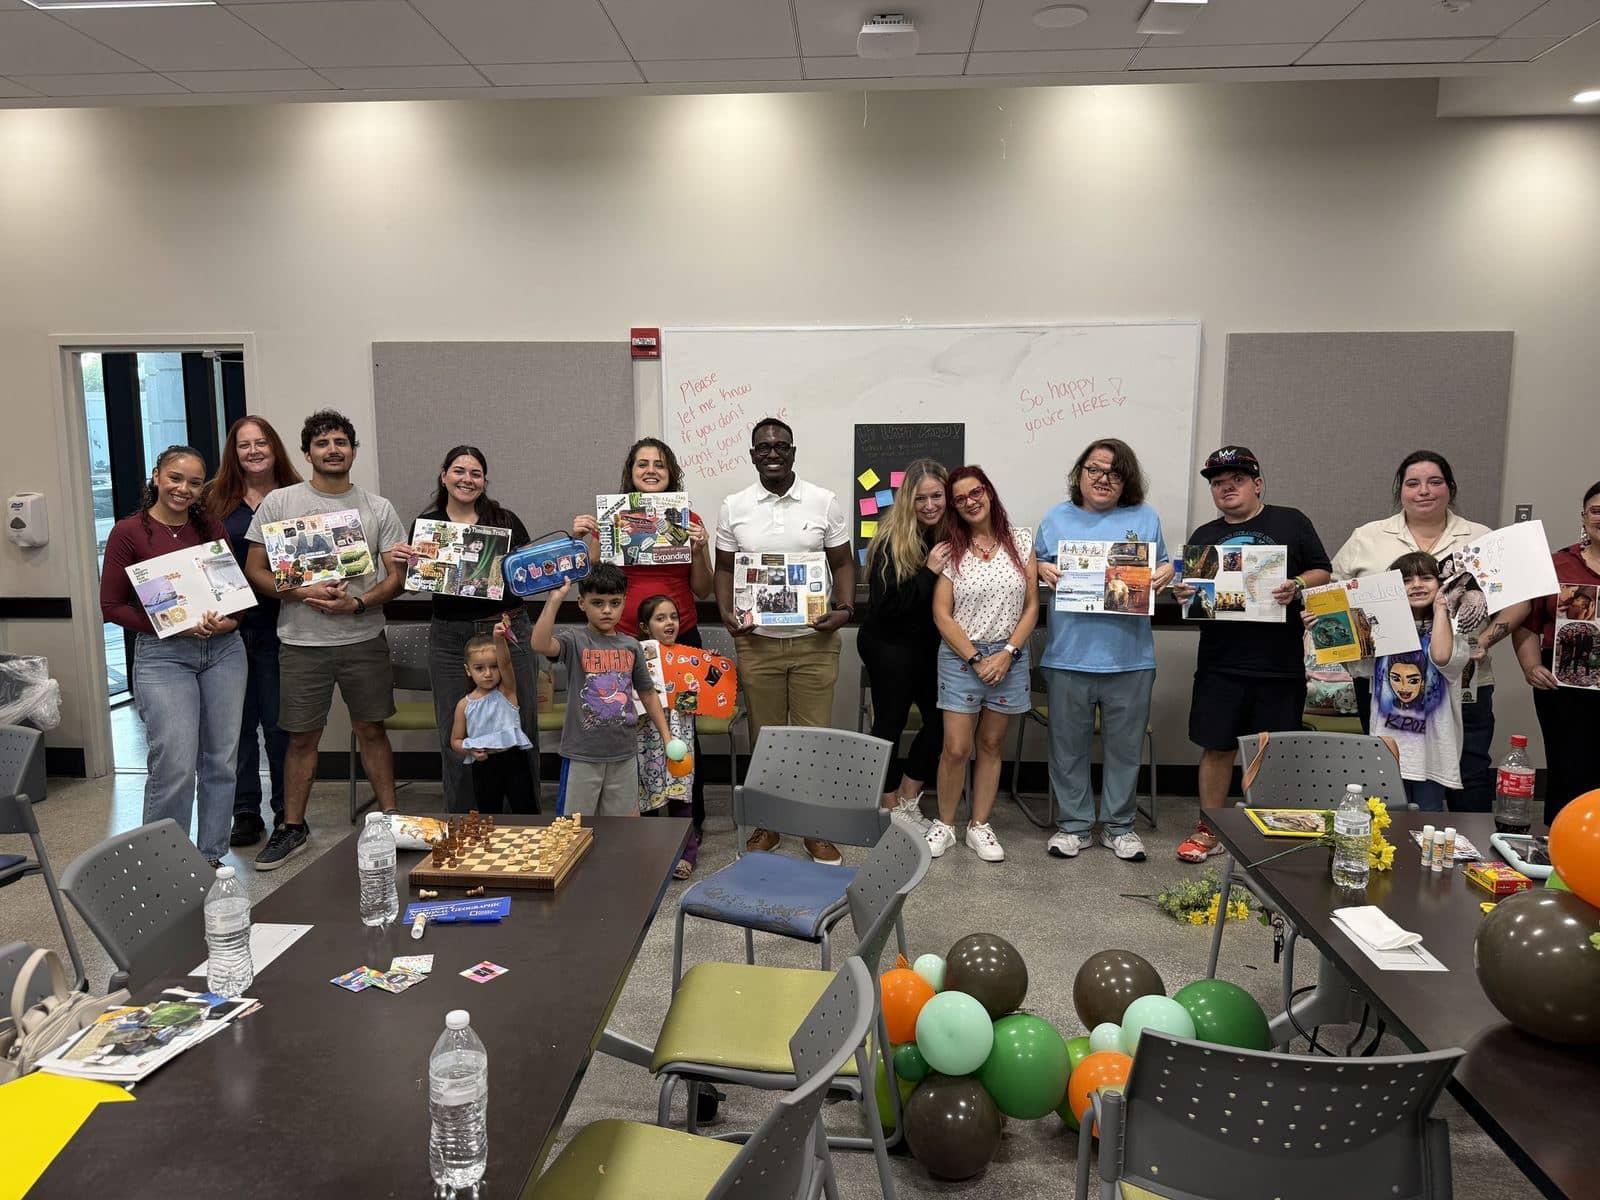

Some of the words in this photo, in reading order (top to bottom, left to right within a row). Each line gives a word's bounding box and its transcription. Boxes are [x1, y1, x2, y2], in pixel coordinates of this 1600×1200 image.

[680, 372, 717, 404] Please
[1020, 388, 1044, 412] So
[1047, 377, 1095, 401] happy
[677, 406, 696, 428] let
[699, 398, 716, 414] me
[719, 383, 752, 400] know
[679, 447, 713, 469] want
[716, 427, 744, 456] your
[680, 430, 692, 444] if
[695, 423, 716, 446] you
[696, 454, 748, 479] taken
[653, 552, 691, 563] Expanding
